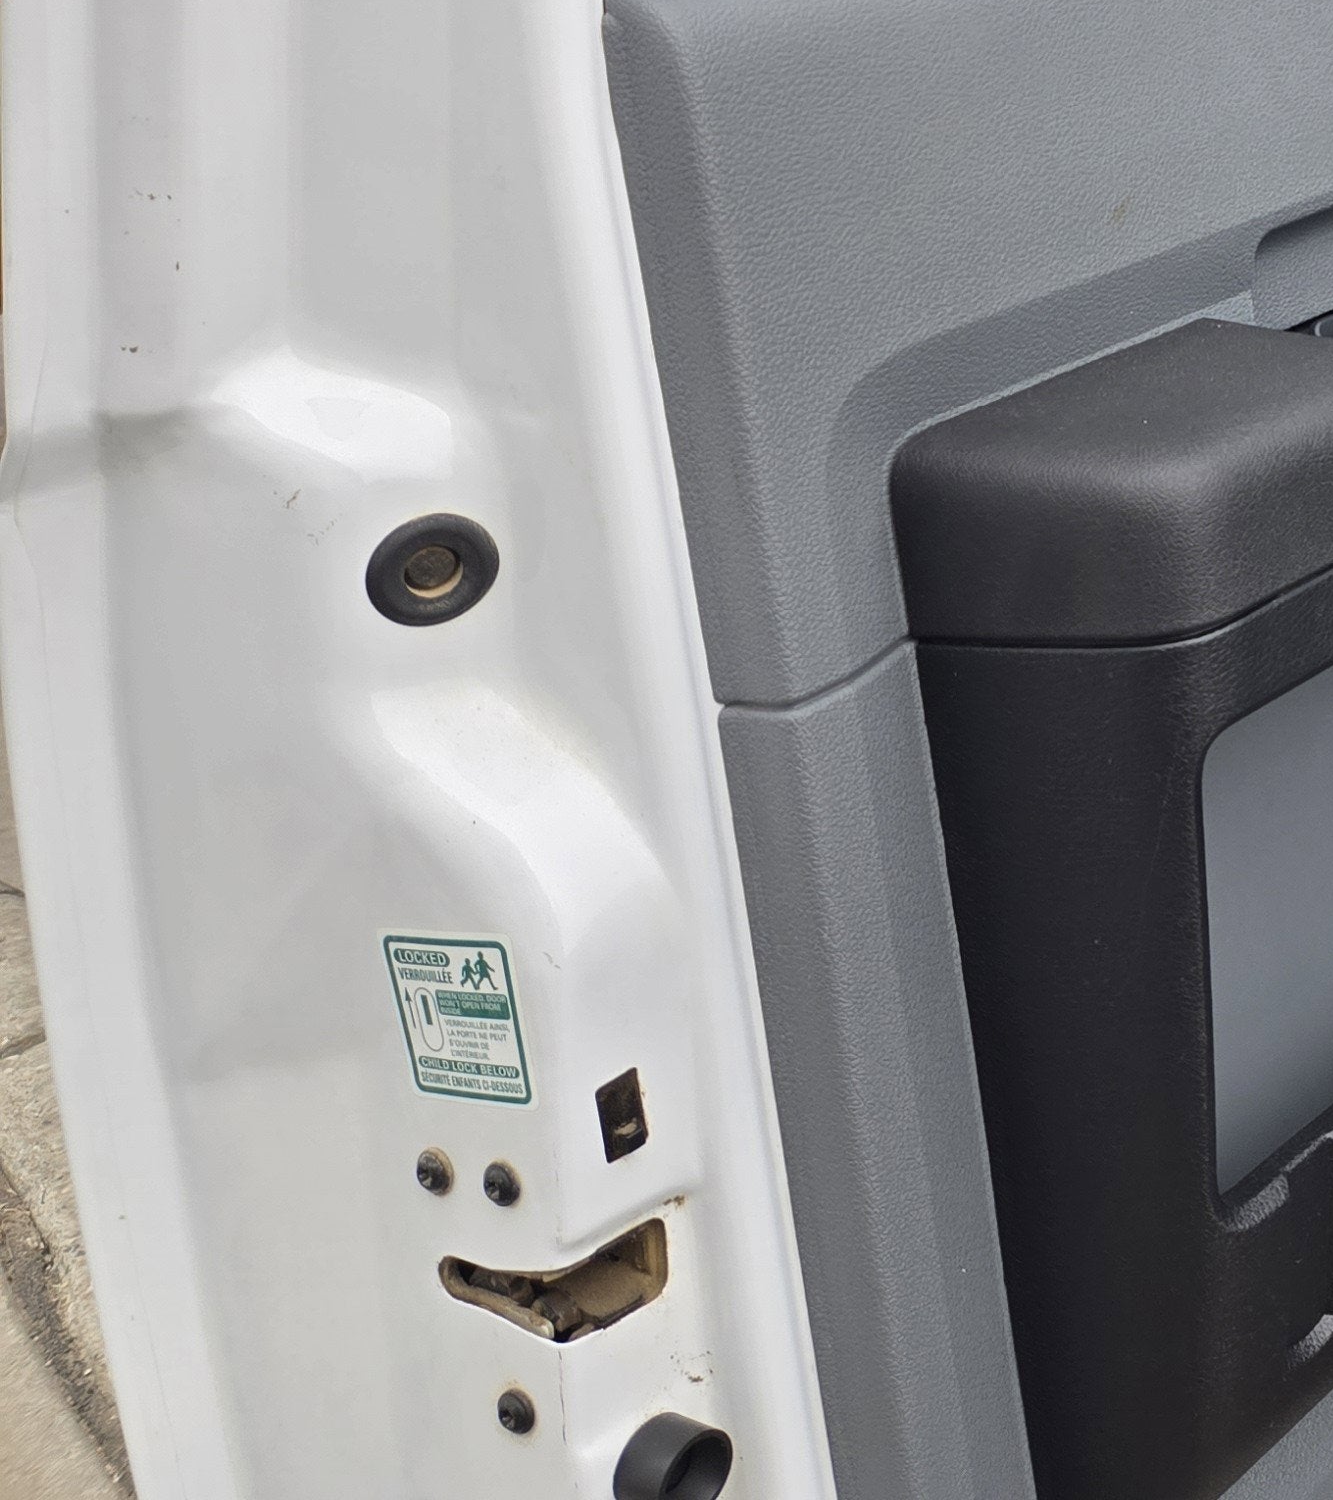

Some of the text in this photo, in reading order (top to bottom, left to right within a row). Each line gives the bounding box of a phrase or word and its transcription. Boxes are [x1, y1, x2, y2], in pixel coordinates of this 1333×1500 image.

[398, 949, 447, 966] LOCKED
[398, 967, 454, 985] VERROUILLÉE
[461, 1001, 480, 1010] OPEN
[486, 995, 507, 1004] DOOR
[447, 1028, 507, 1042] LA PORTE NE PEUT
[421, 1057, 517, 1078] CHILD LOCK BELOW
[421, 1069, 524, 1095] SÉCURITÉ ENFANTS CI-DESSOUS
